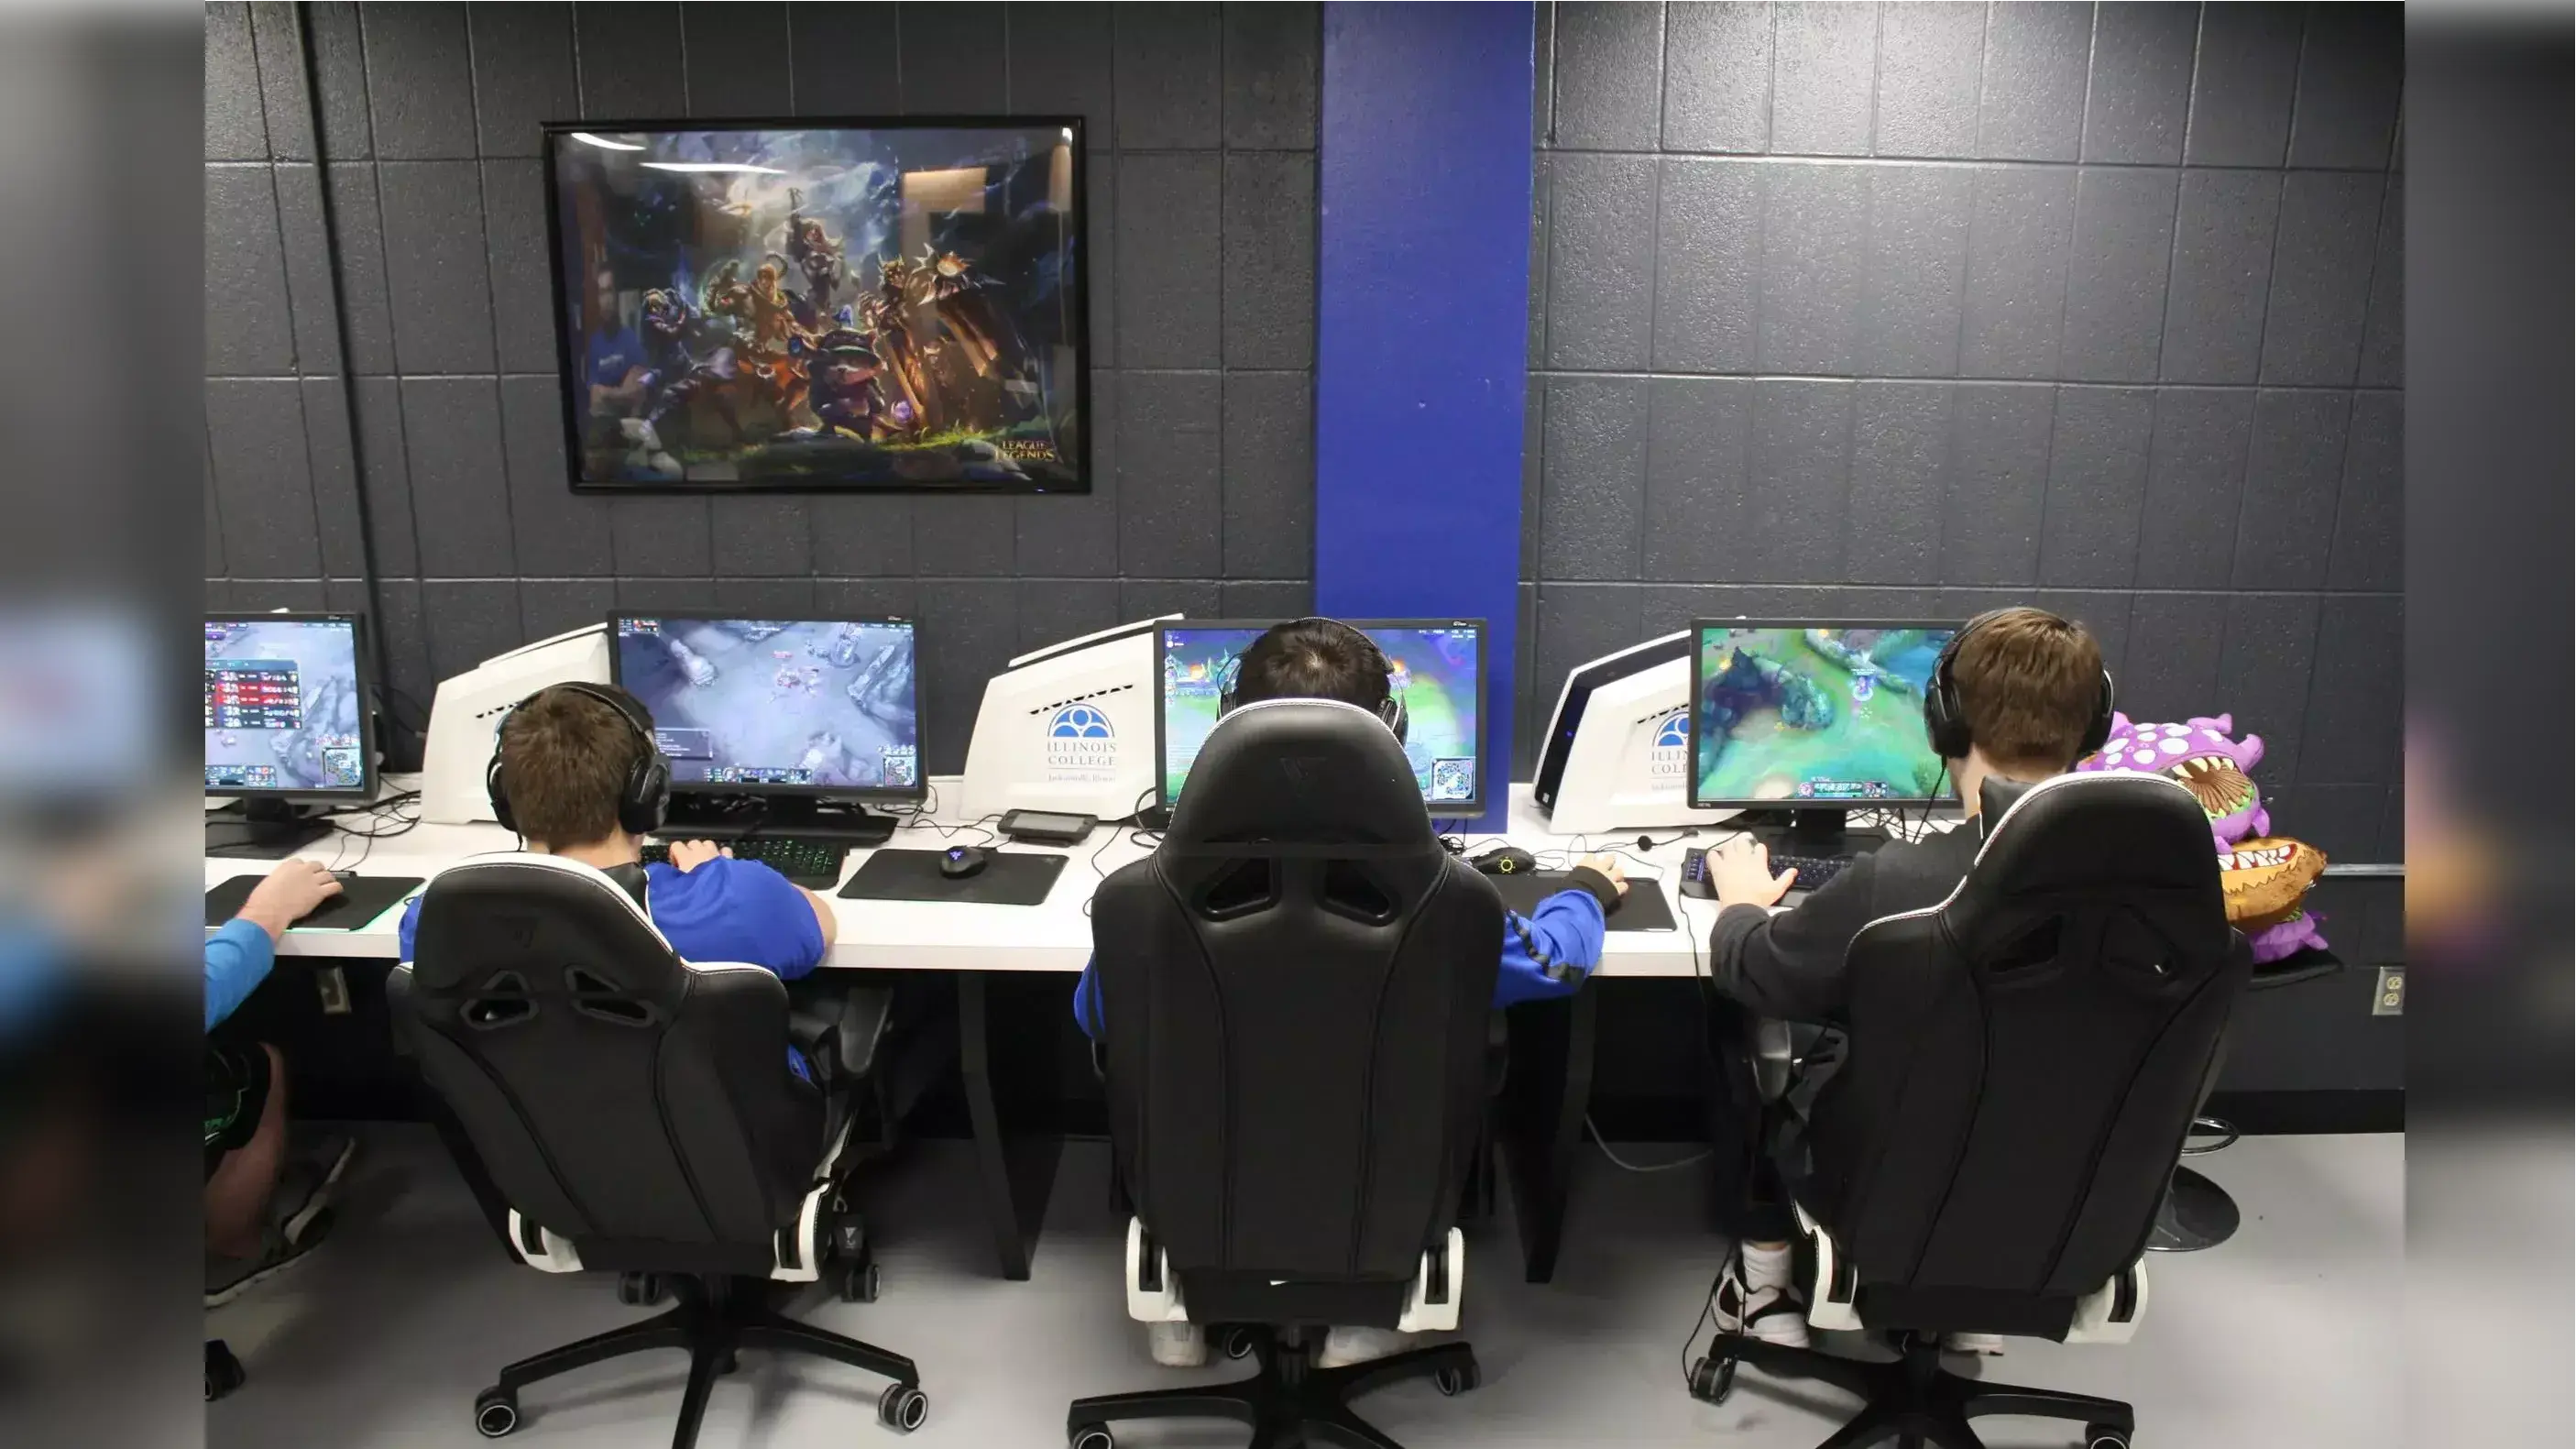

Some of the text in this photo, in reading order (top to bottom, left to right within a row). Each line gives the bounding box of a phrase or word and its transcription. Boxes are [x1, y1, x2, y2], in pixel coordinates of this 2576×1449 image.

[1047, 741, 1117, 752] ILLINOIS
[1047, 754, 1115, 766] COLLEGE
[1651, 763, 1689, 775] COLL
